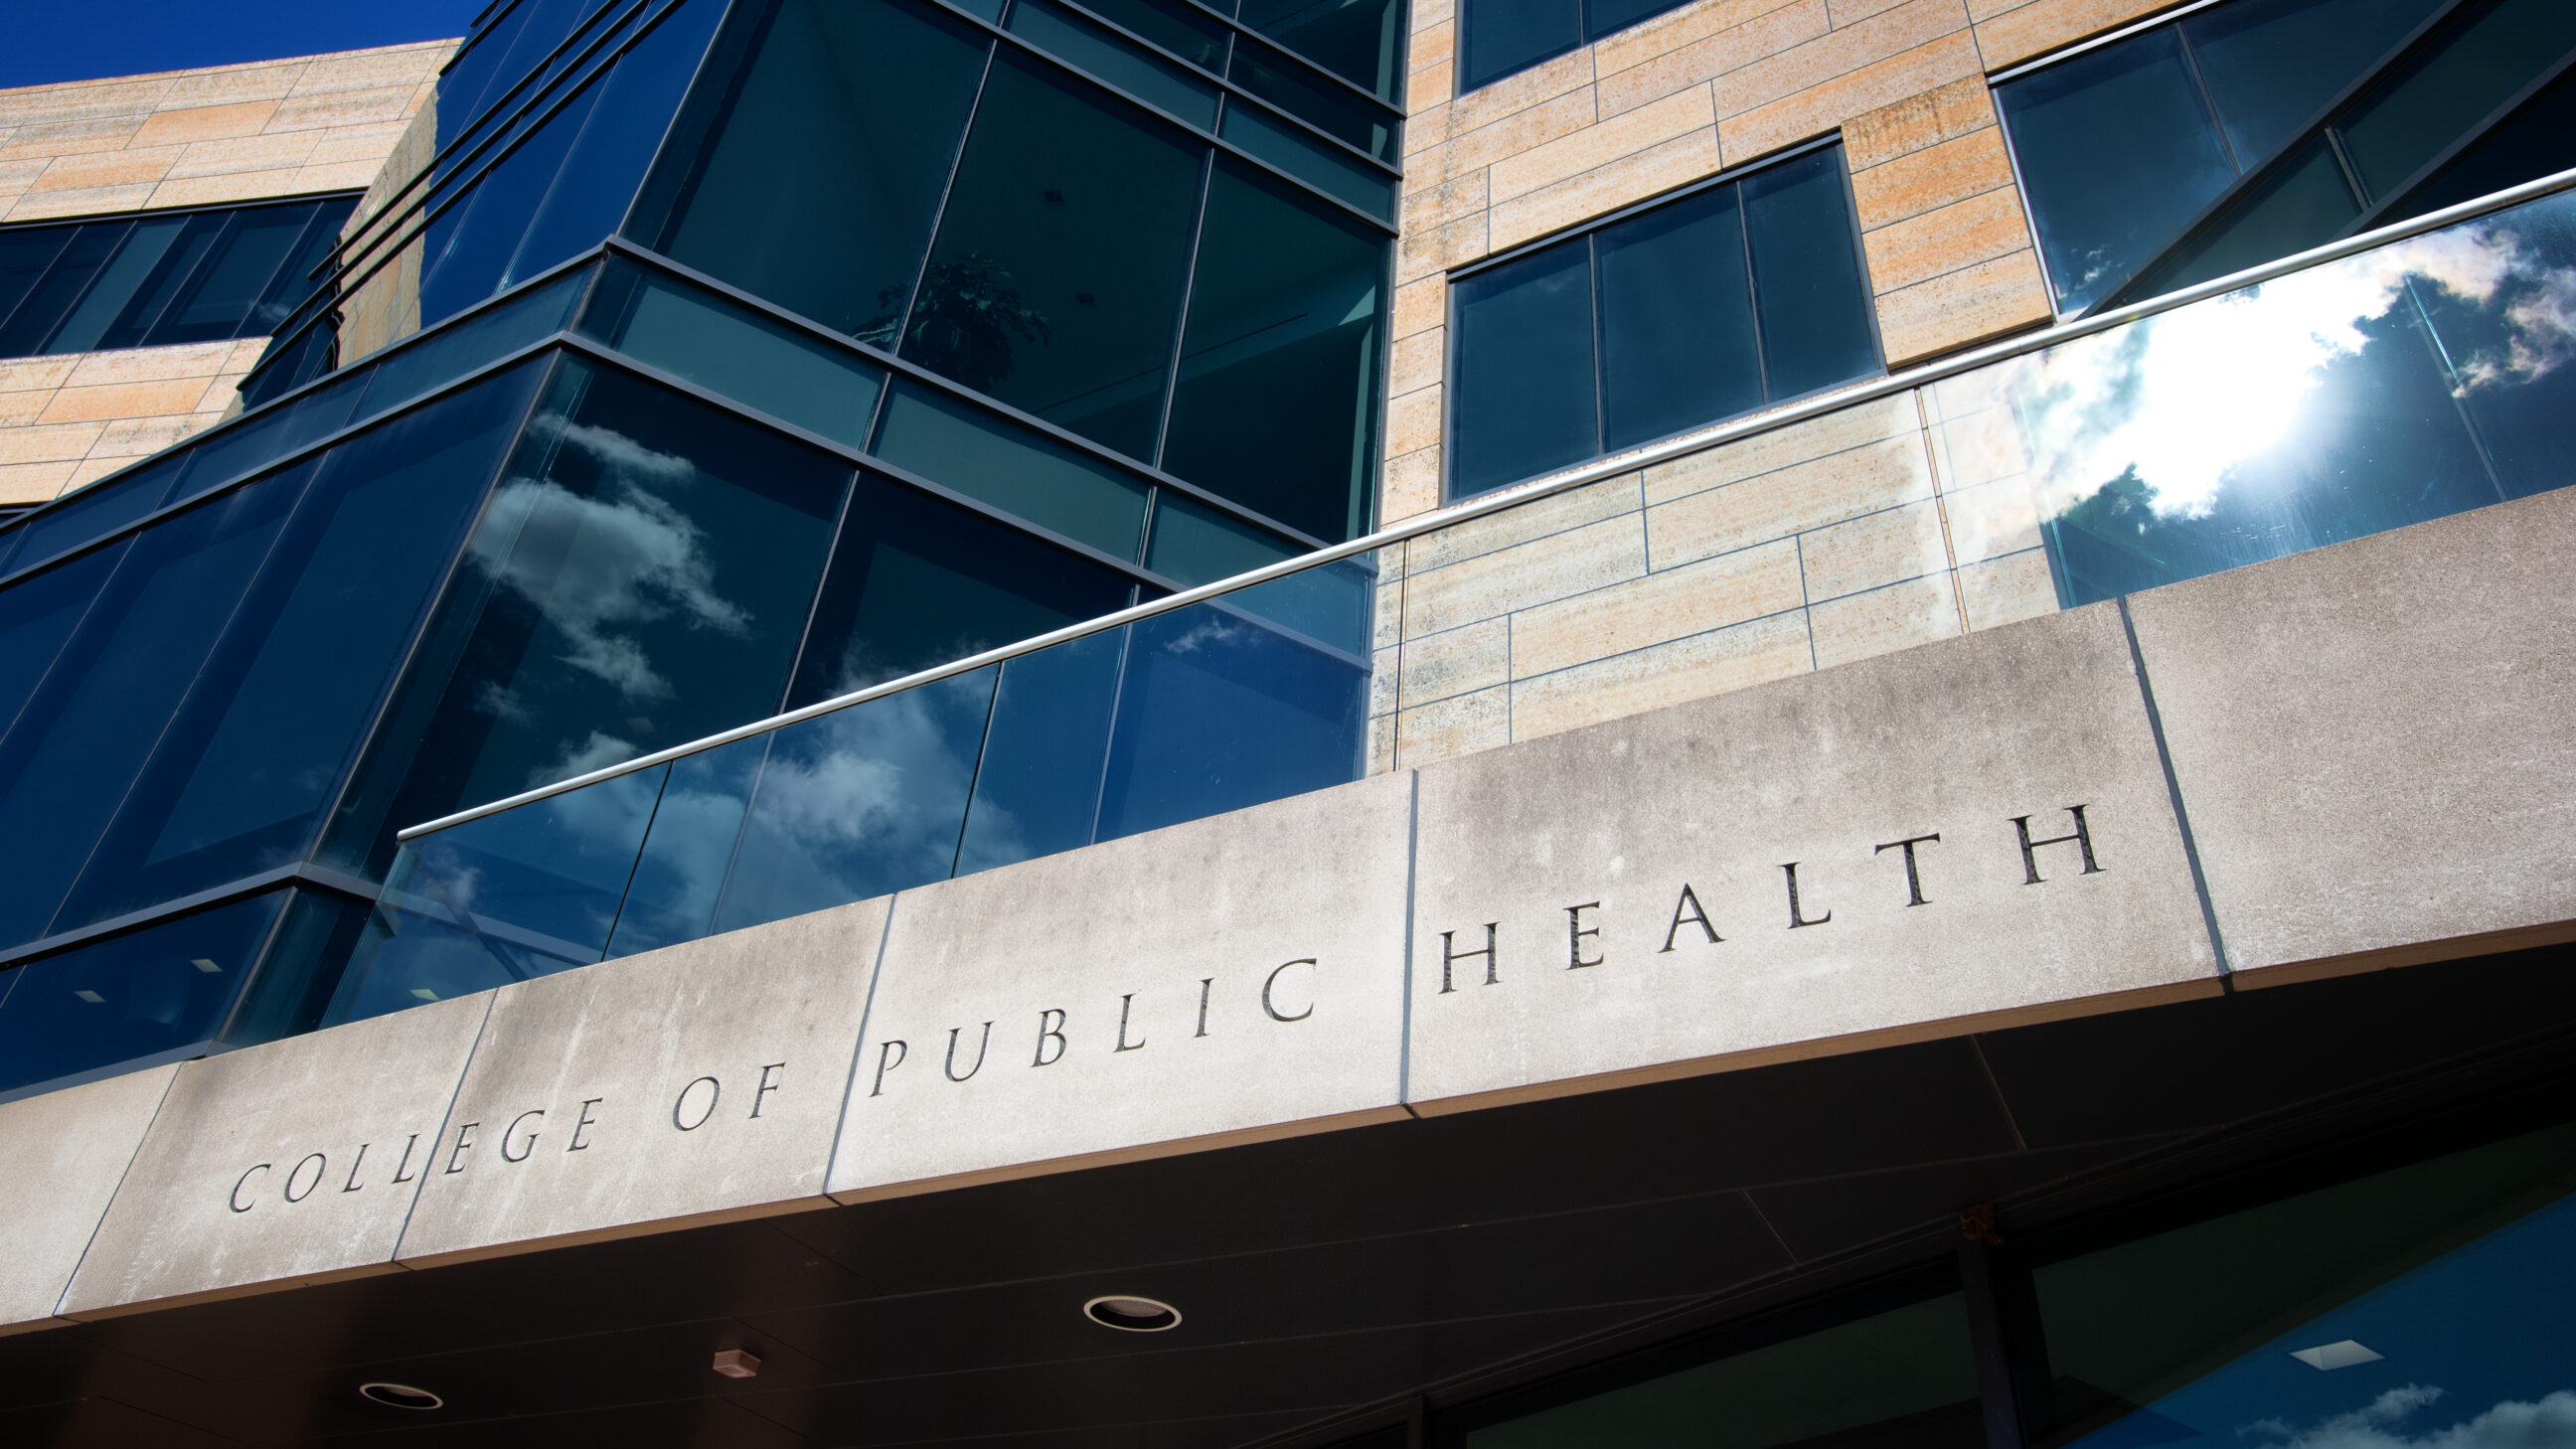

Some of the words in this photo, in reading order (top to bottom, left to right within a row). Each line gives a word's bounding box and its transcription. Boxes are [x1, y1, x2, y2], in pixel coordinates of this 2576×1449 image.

[230, 1097, 603, 1213] COLLEGE
[673, 1062, 785, 1131] OF
[869, 957, 1317, 1097] PUBLIC
[1438, 804, 2107, 994] HEALTH
